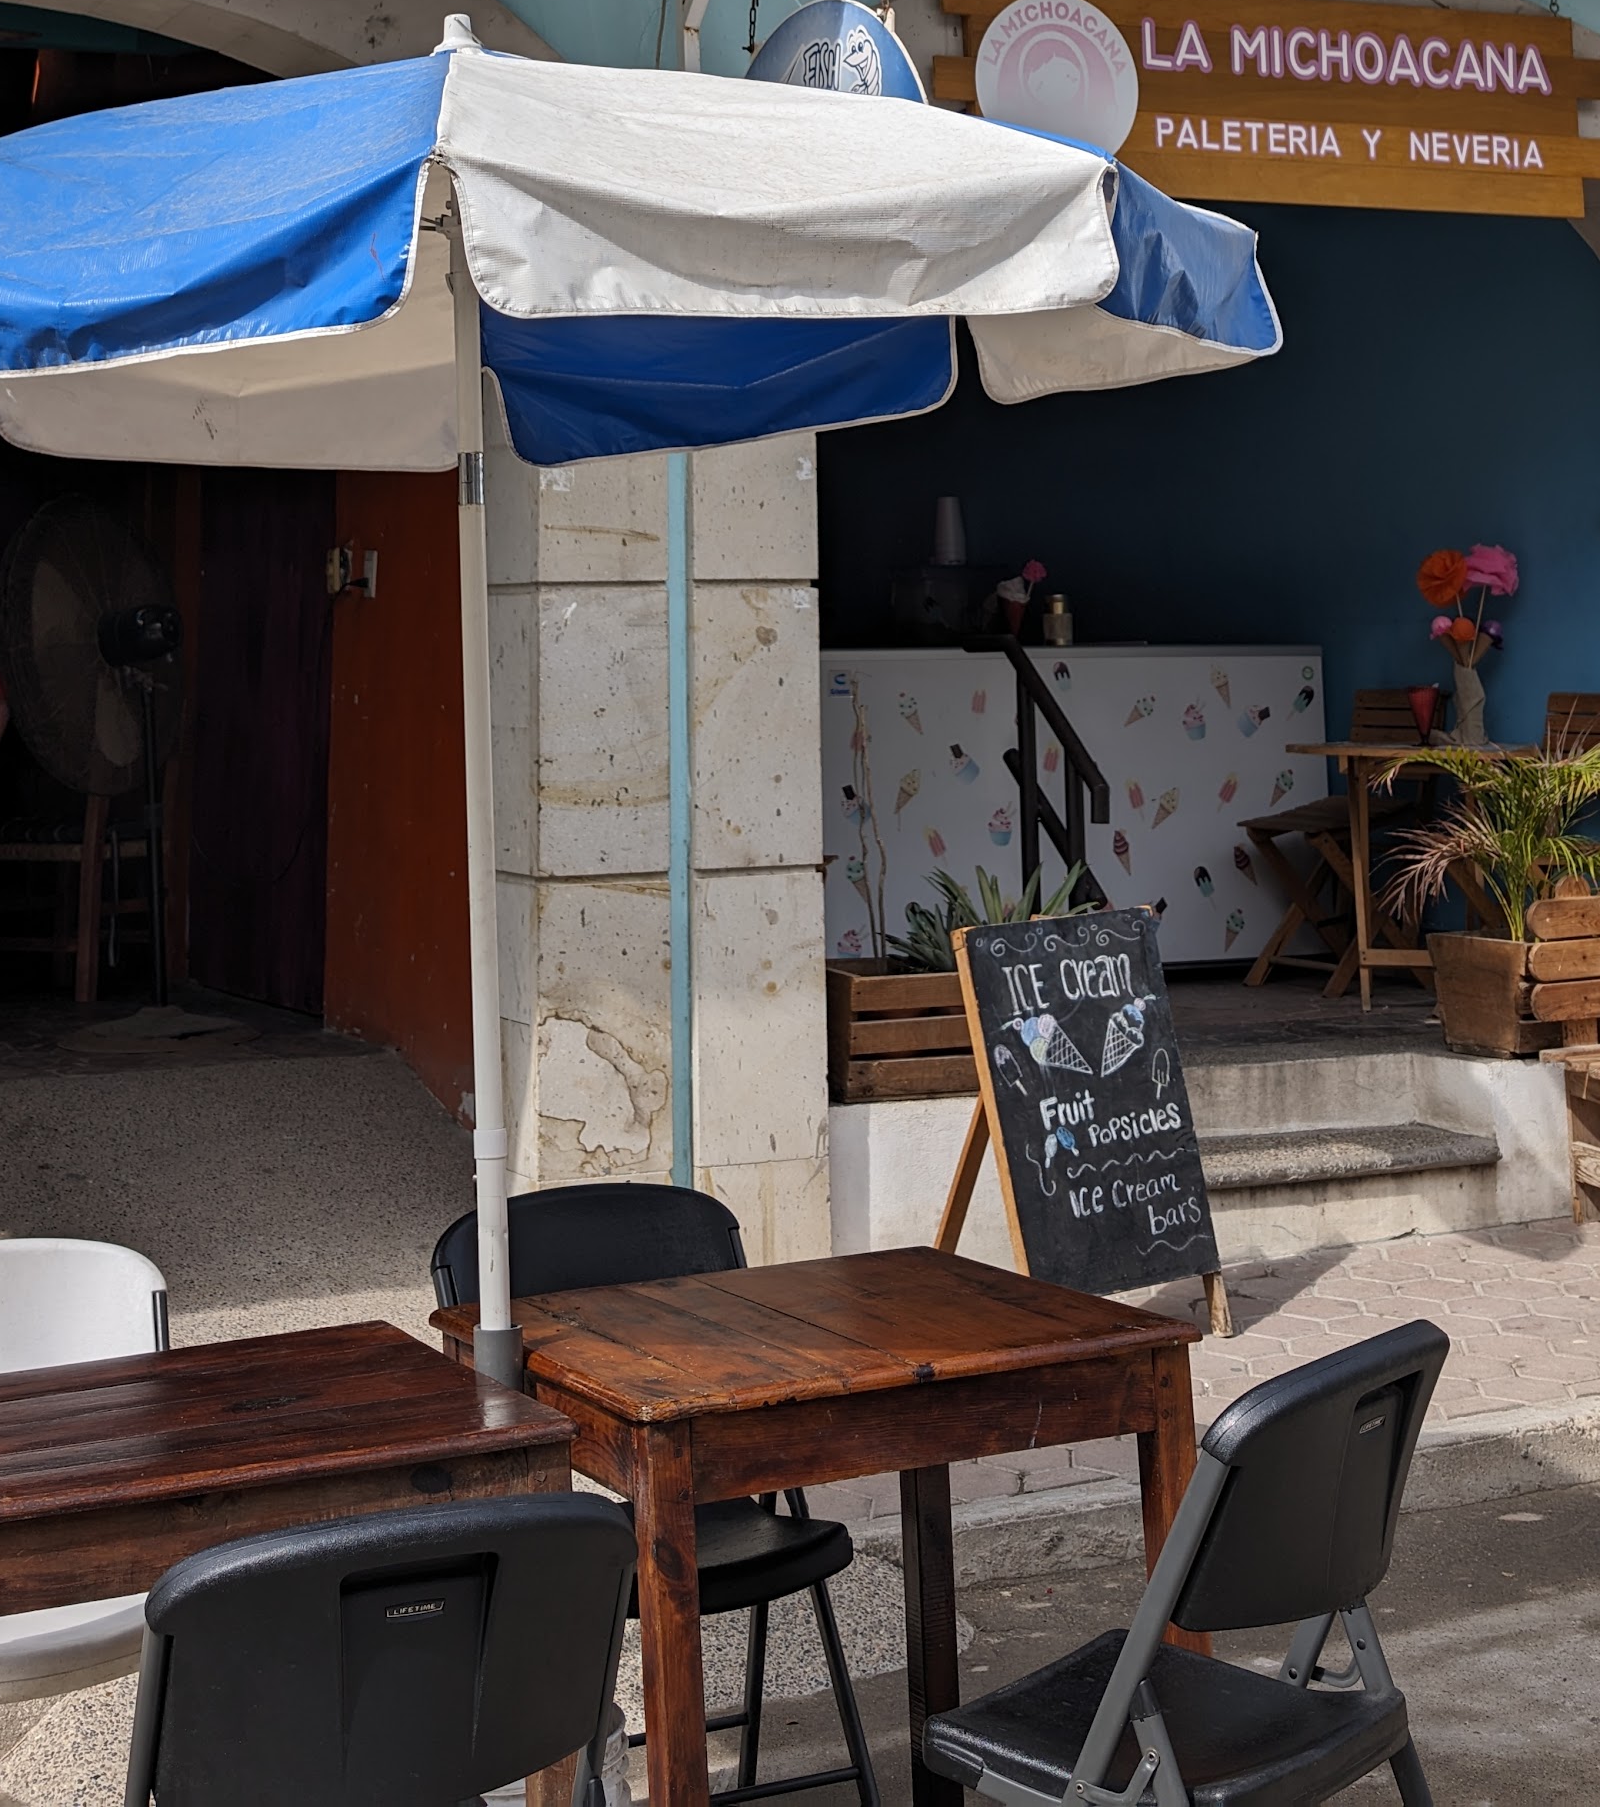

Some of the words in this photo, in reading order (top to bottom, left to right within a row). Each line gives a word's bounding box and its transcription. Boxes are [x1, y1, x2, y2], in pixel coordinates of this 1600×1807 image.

[983, 38, 1006, 66] LA
[1000, 0, 1128, 76] MICHOACANA
[1142, 18, 1212, 72] LA
[1230, 24, 1552, 95] MICHOACANA
[1155, 116, 1342, 158] PALETERIA
[1360, 129, 1382, 160] Y
[1408, 131, 1544, 170] NEVERIA
[1001, 963, 1050, 1016] ICE
[1039, 1089, 1095, 1131] Fruit
[1111, 1173, 1181, 1208] Cream
[1147, 1196, 1202, 1236] bars
[393, 1602, 437, 1615] LIFETIME
